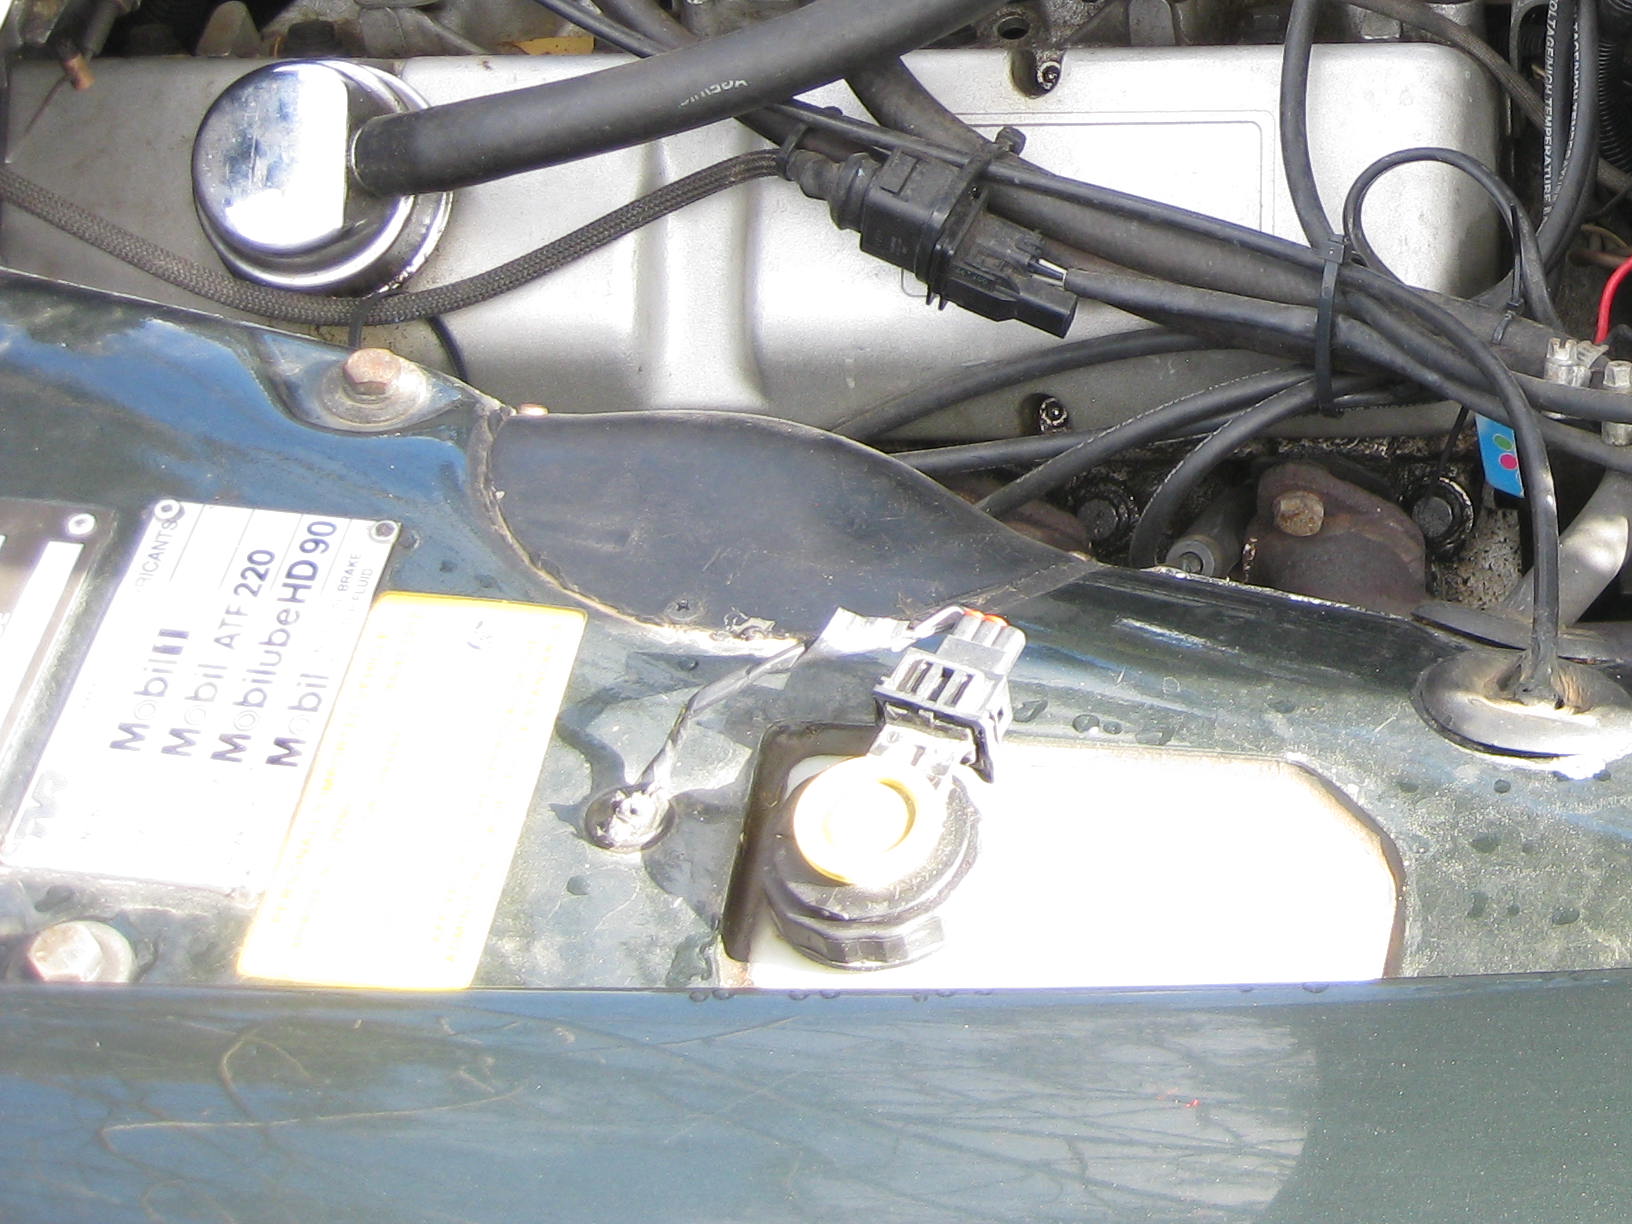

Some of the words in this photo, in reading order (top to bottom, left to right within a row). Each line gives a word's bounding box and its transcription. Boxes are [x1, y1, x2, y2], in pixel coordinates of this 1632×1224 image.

[1543, 97, 1553, 202] TEMPERATURE
[300, 521, 337, 554] 90
[161, 663, 227, 757] Mobil
[214, 605, 248, 649] ATF
[234, 550, 275, 597] 220
[266, 673, 328, 767] Mobil
[338, 553, 361, 592] BRAKE
